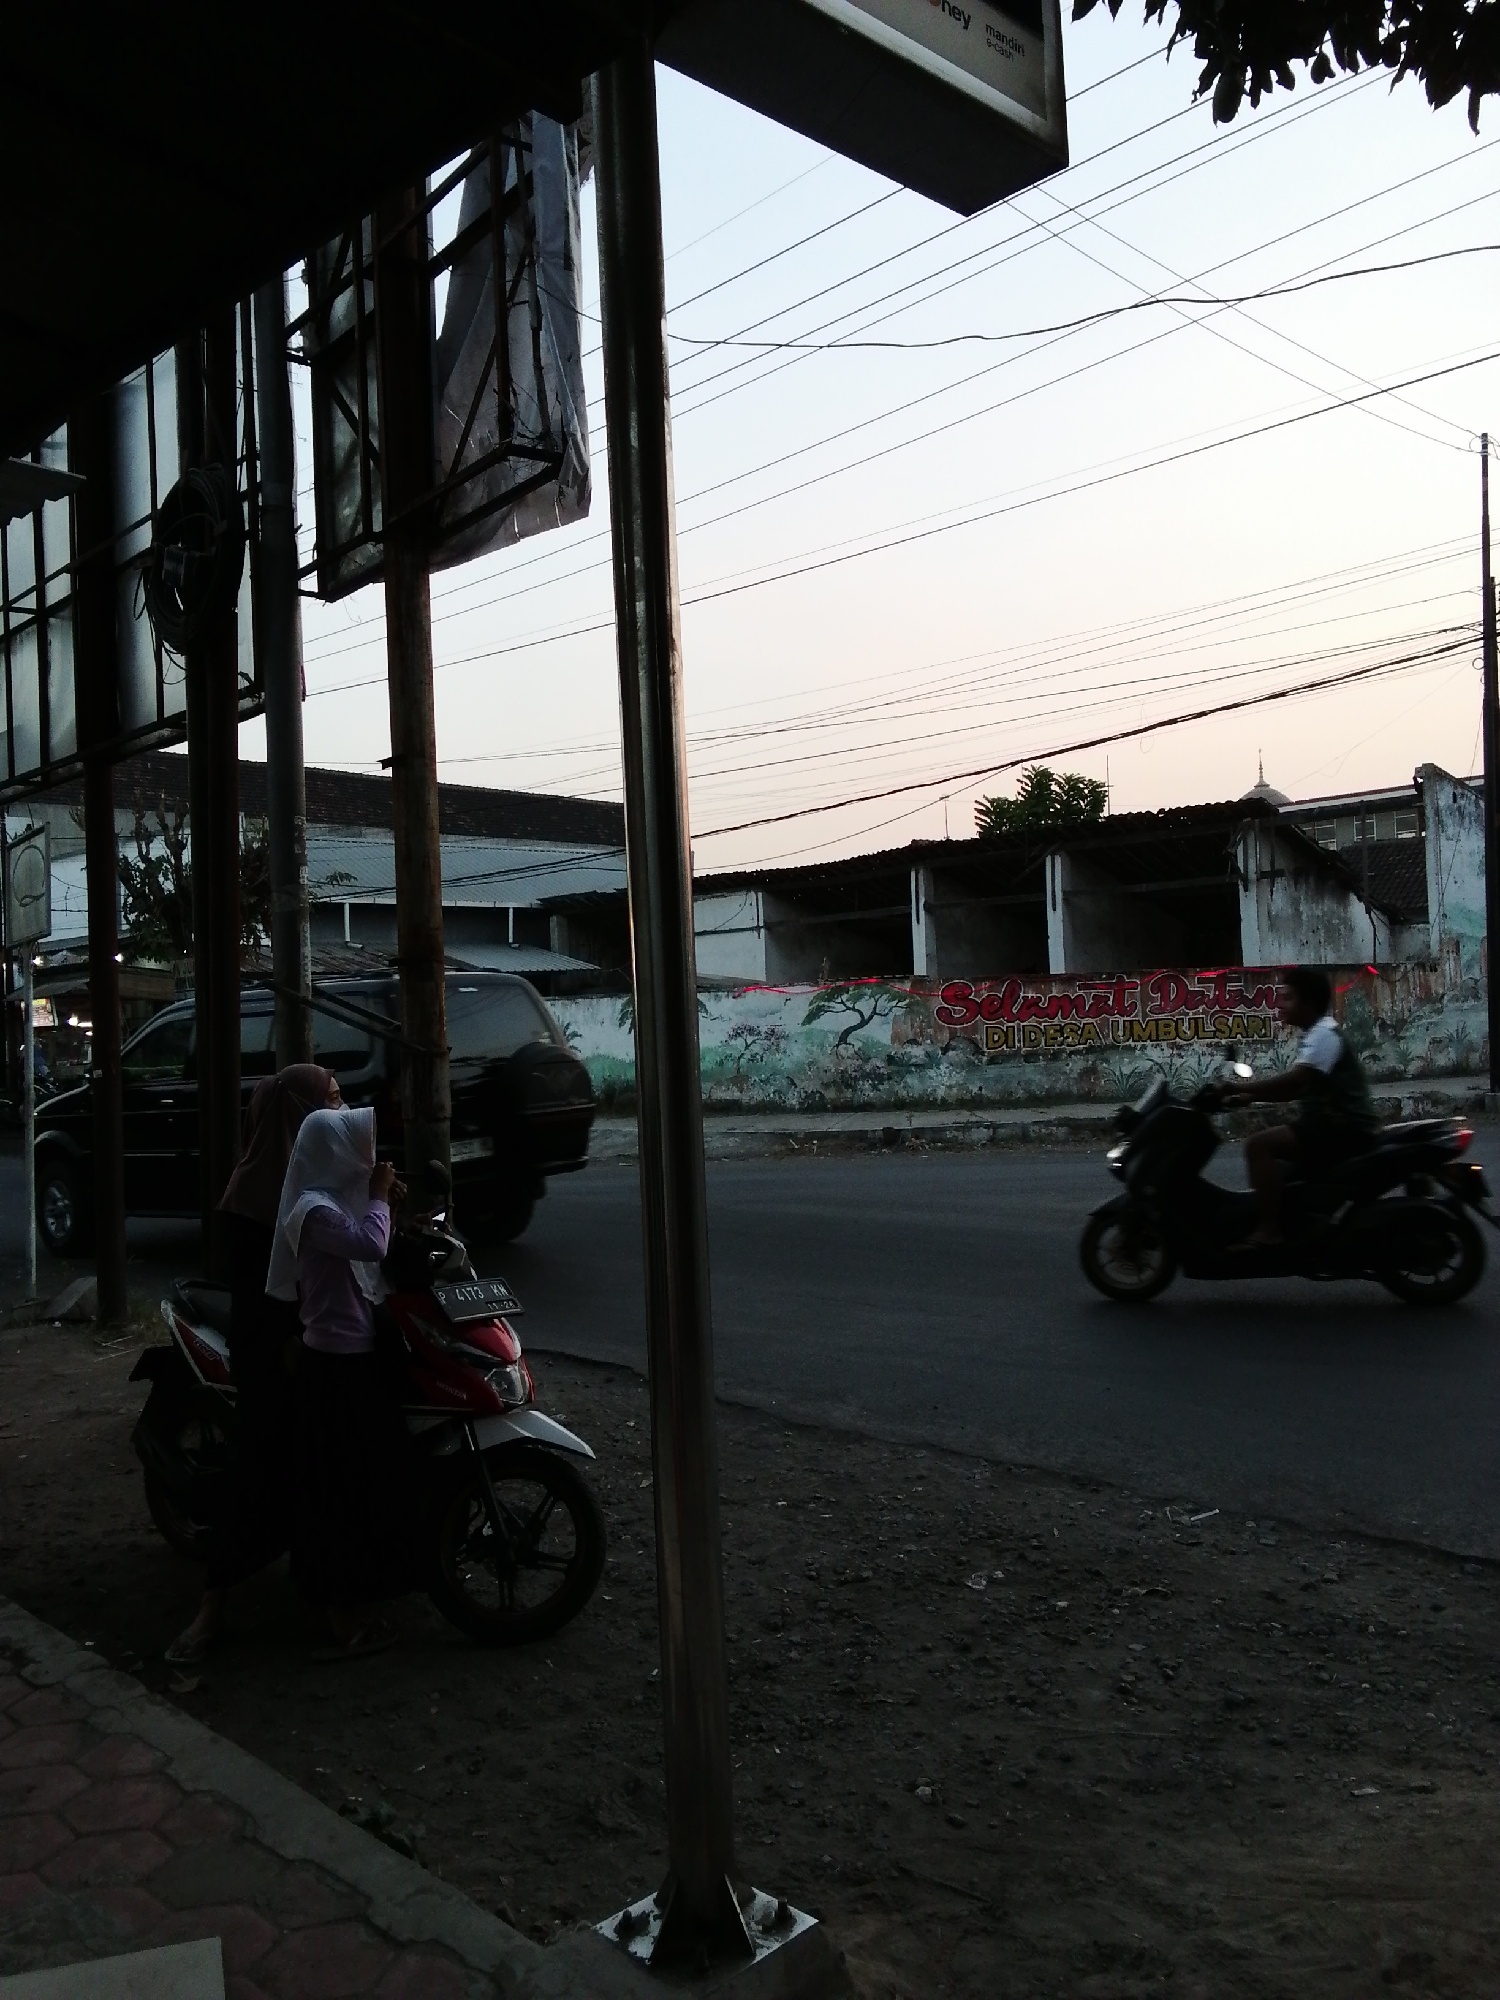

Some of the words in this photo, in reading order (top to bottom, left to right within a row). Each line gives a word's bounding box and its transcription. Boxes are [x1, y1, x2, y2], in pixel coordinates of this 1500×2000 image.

[985, 24, 1025, 57] mandiri
[986, 38, 1014, 61] e-cash
[935, 975, 1139, 1026] Selamat
[1146, 972, 1283, 1018] Datan
[985, 1024, 1017, 1051] DI
[1021, 1022, 1103, 1049] DESA
[1111, 1014, 1272, 1044] UMBULSARI
[437, 1291, 447, 1305] P
[456, 1286, 485, 1302] 4173
